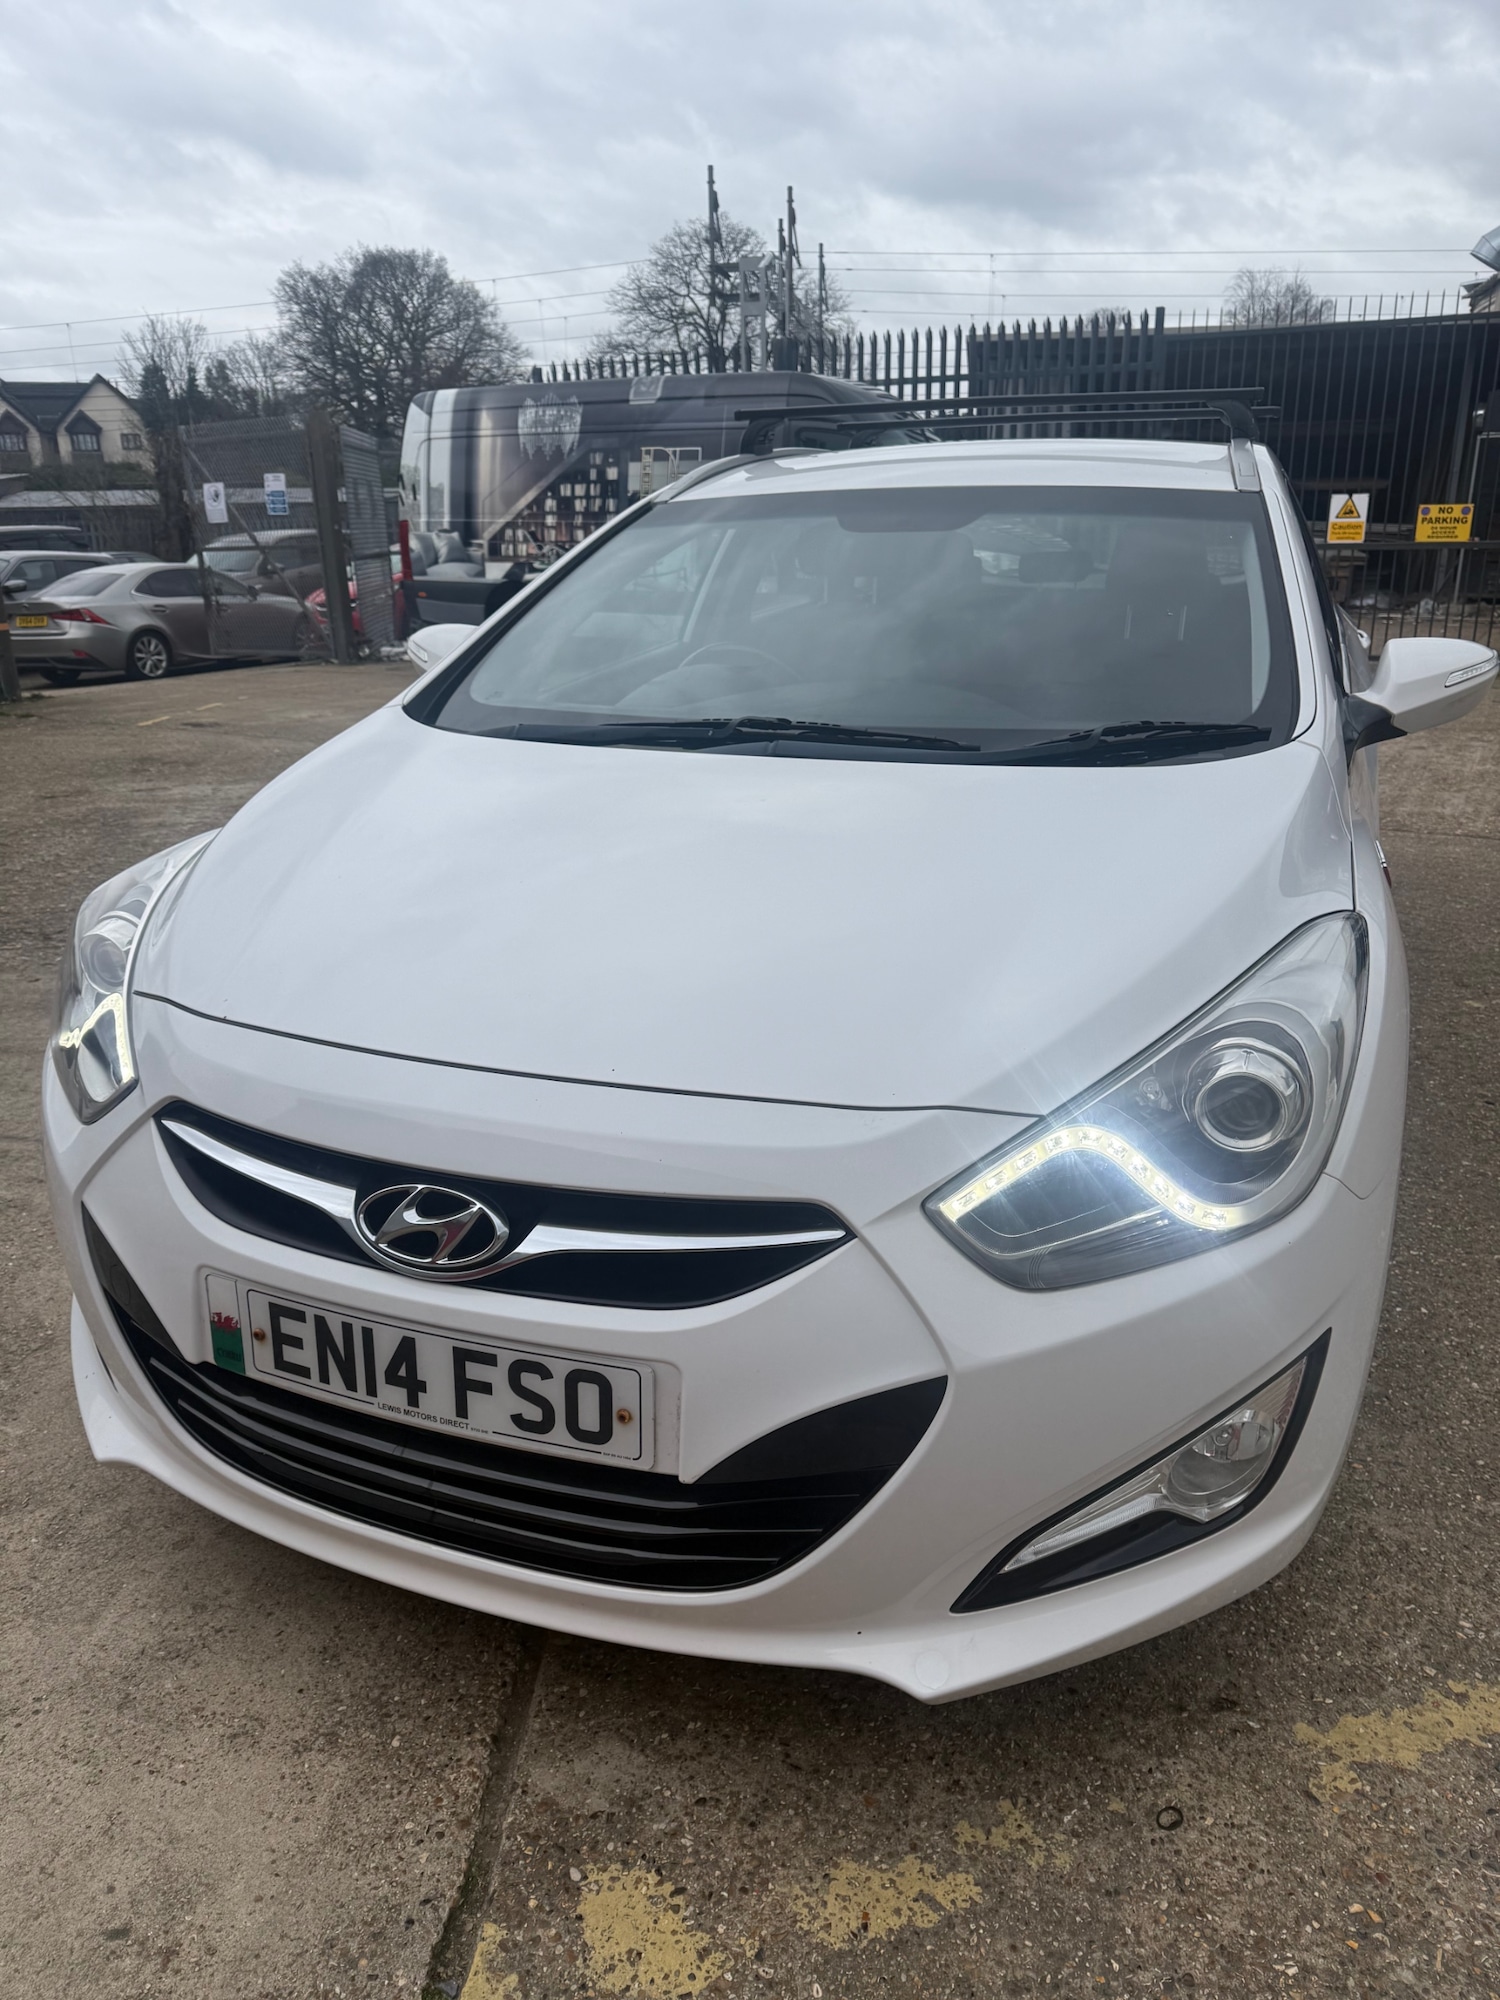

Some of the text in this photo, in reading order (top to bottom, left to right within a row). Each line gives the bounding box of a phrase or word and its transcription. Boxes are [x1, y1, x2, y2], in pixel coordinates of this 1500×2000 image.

[1438, 506, 1454, 514] NO
[1421, 516, 1468, 525] PARKING
[1332, 523, 1362, 531] Caution
[268, 1301, 613, 1445] EN14 FSO
[377, 1402, 469, 1430] LEWIS MOTORS DIRECT
